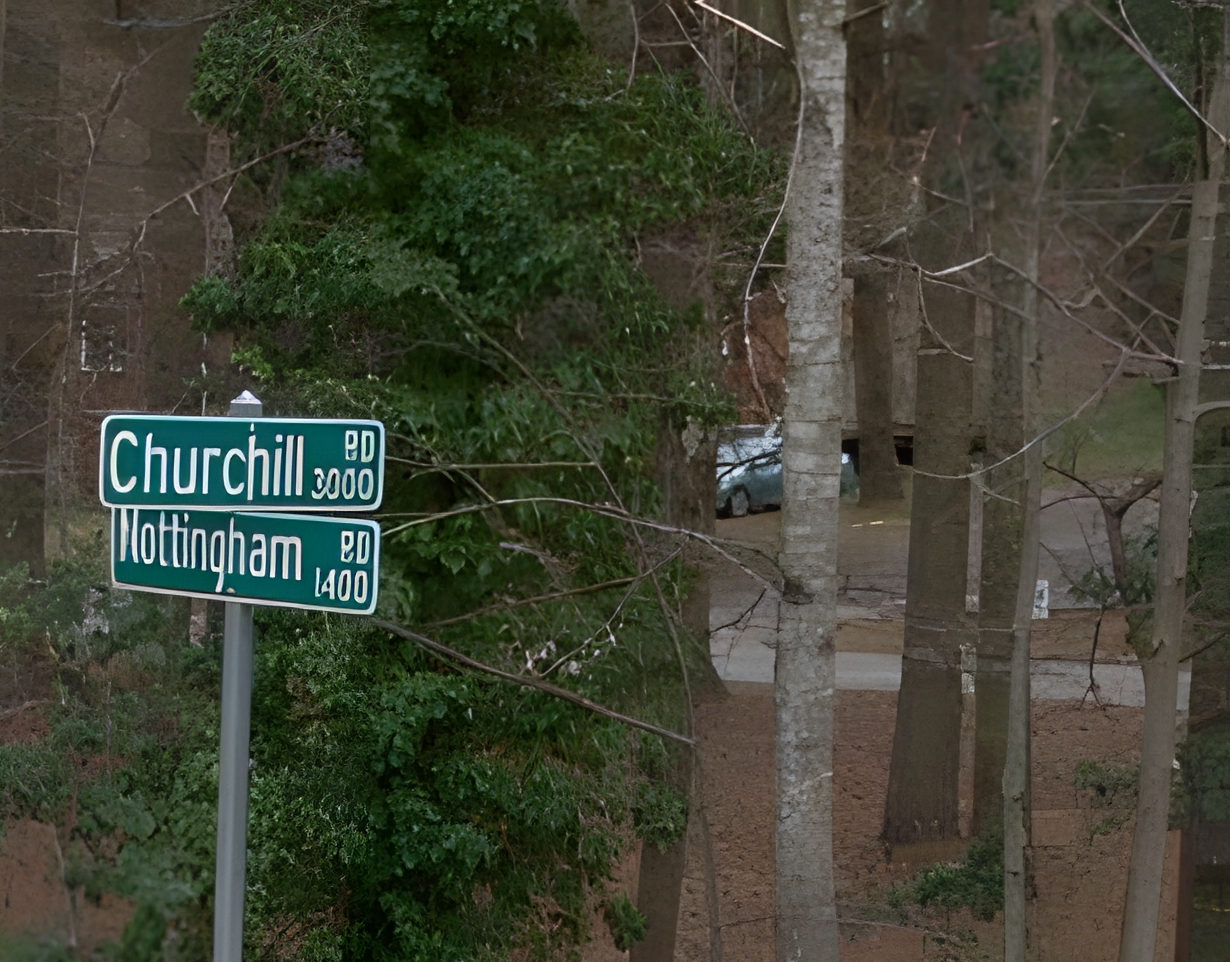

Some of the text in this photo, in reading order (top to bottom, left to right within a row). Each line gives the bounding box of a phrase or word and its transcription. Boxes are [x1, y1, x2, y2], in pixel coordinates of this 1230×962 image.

[109, 423, 305, 501] Churchill
[120, 508, 302, 593] Nottingham
[314, 567, 368, 604] 1400
